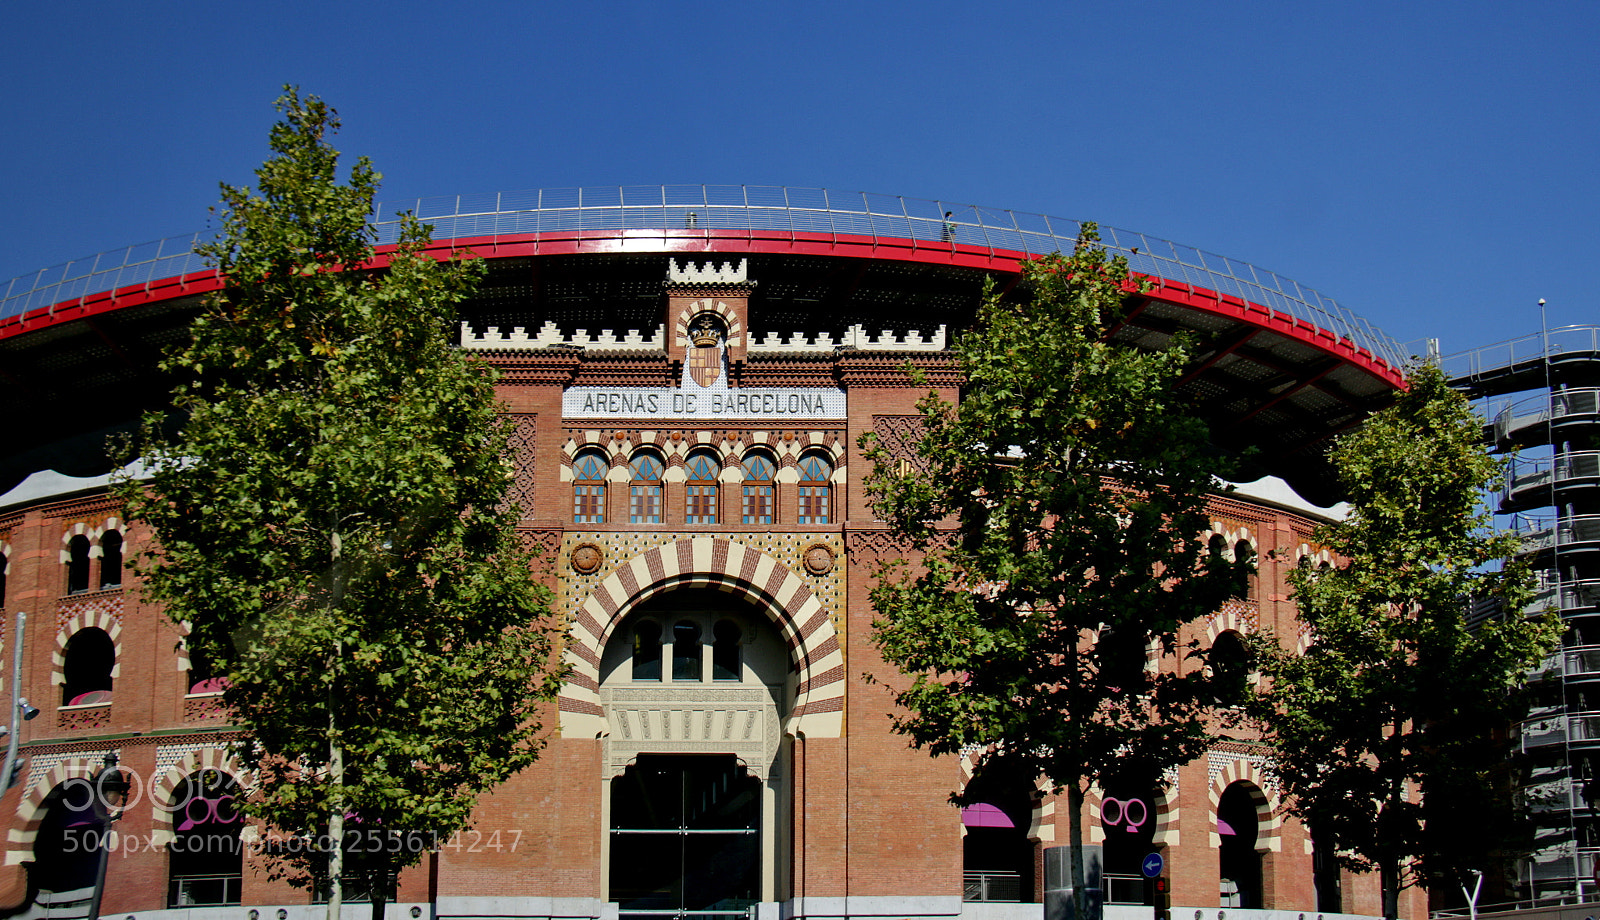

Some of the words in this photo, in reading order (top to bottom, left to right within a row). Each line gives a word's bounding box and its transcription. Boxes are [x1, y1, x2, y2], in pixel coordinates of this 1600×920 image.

[583, 393, 659, 413] ARENAS
[673, 393, 697, 413] DE
[711, 393, 825, 414] BARCELONA
